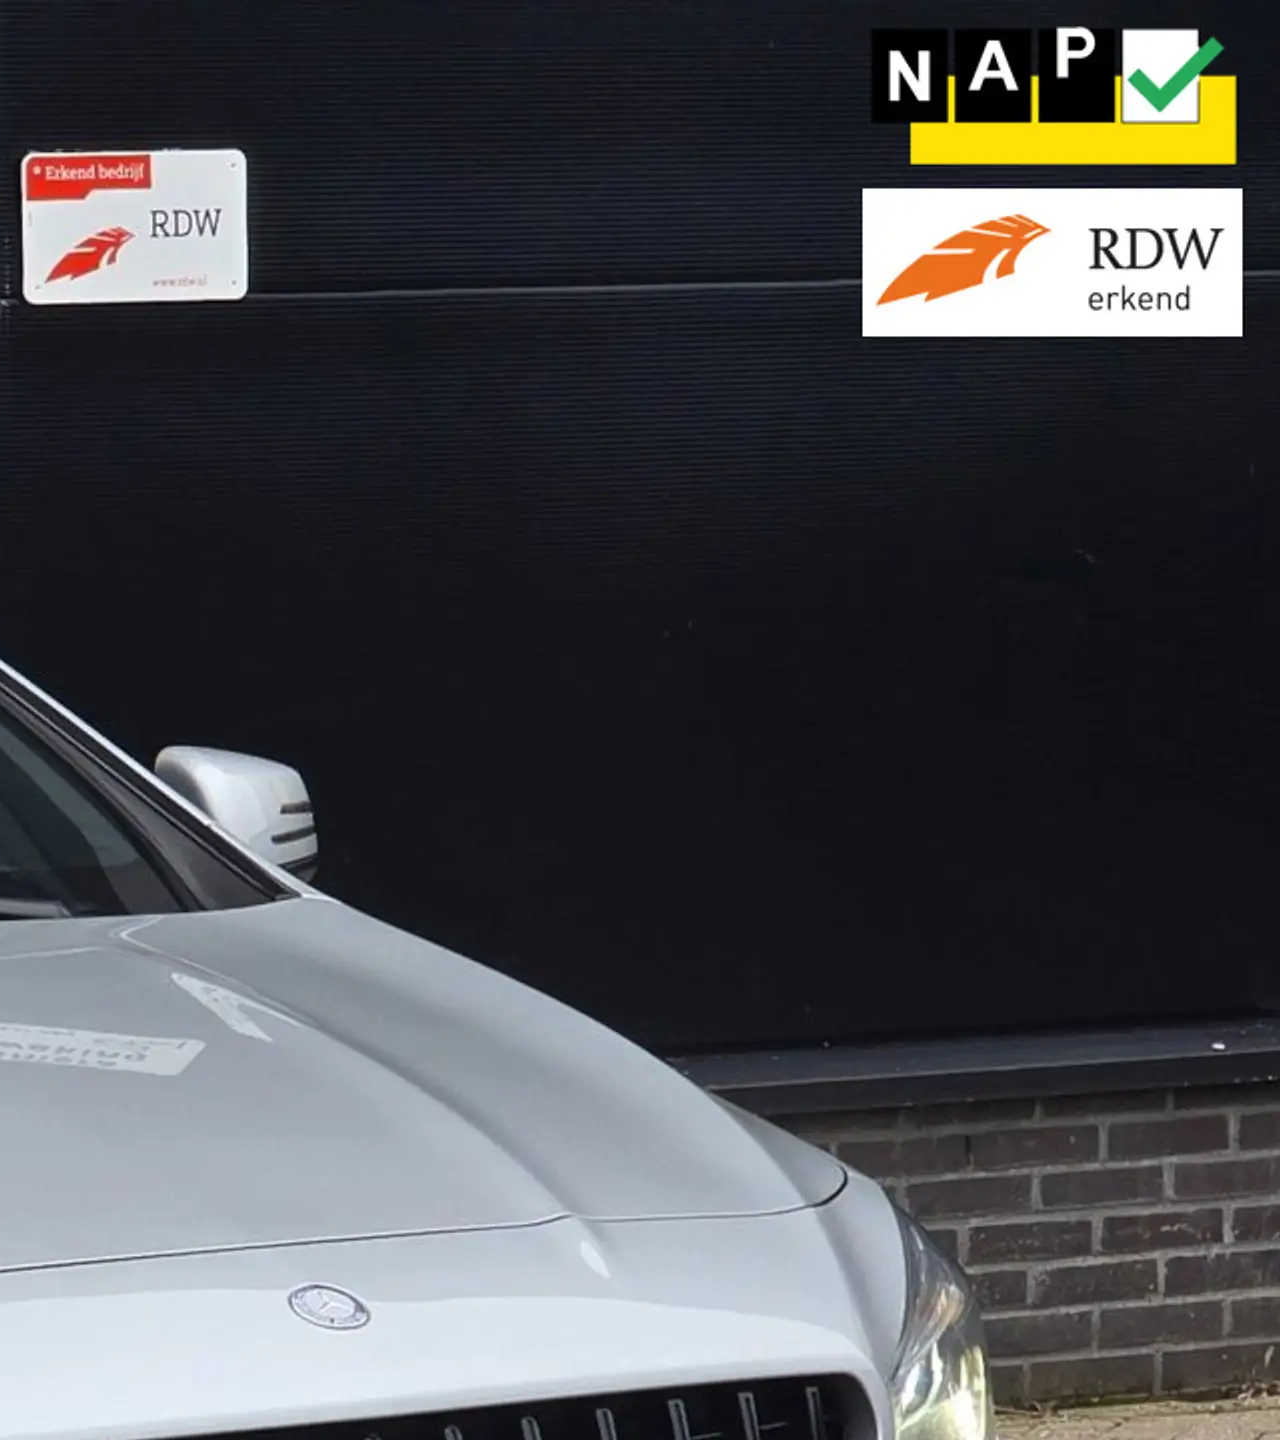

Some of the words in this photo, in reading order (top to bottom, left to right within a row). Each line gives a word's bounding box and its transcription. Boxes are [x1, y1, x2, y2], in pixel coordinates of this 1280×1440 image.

[45, 165, 96, 181] Erkend
[98, 163, 145, 183] bedrijf
[150, 208, 222, 238] RDW
